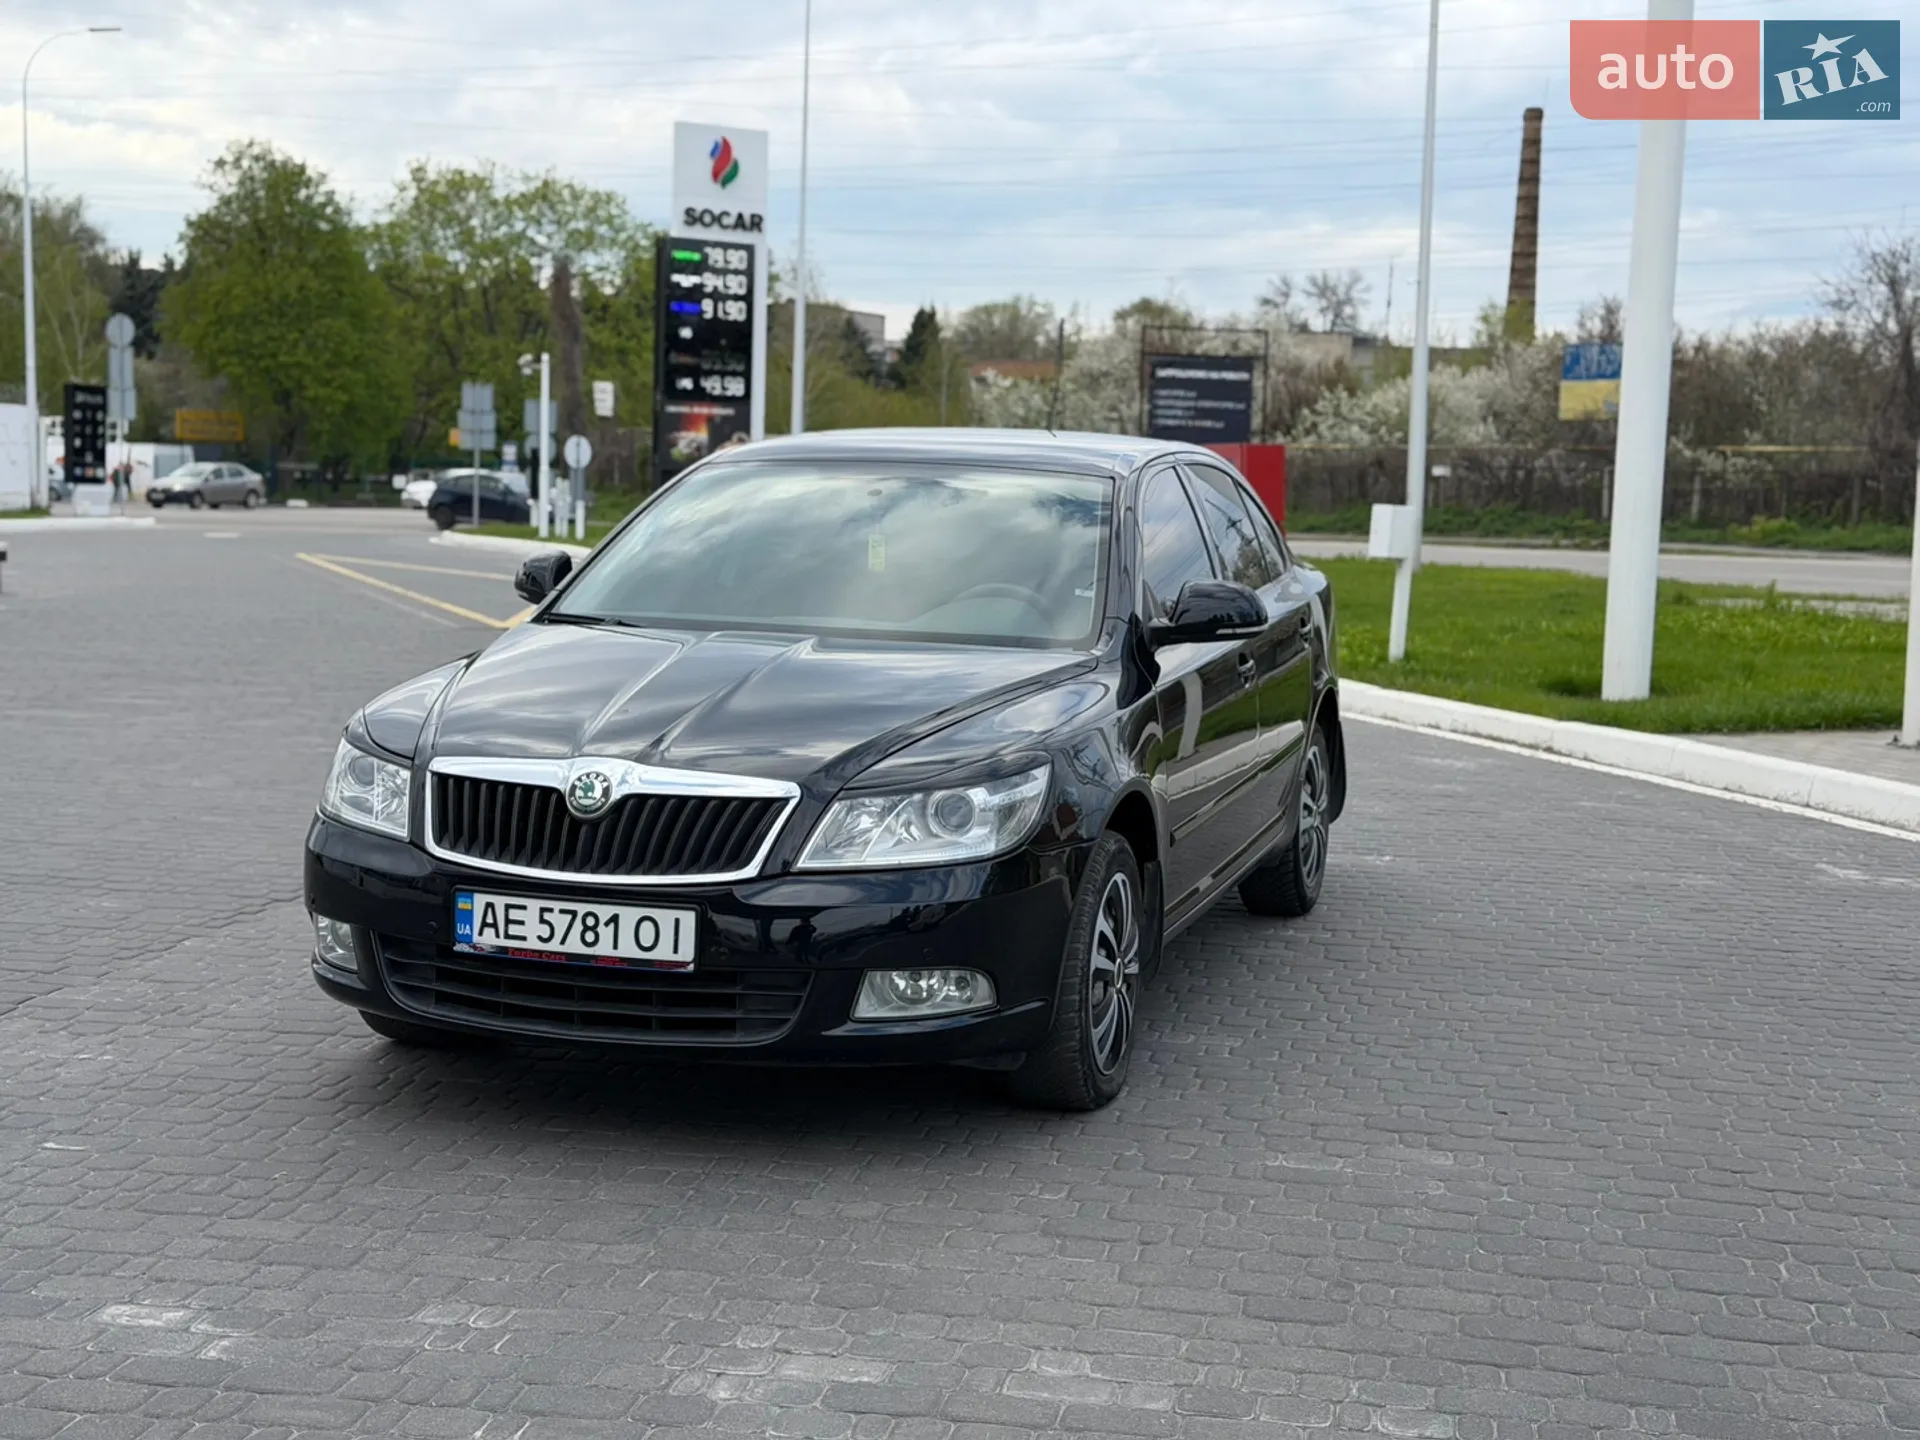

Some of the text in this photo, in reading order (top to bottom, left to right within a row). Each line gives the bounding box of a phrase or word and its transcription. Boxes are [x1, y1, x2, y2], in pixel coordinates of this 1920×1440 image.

[683, 206, 764, 233] SOCAR
[457, 923, 472, 936] UA
[477, 901, 528, 942] AE
[536, 906, 620, 951] 5781
